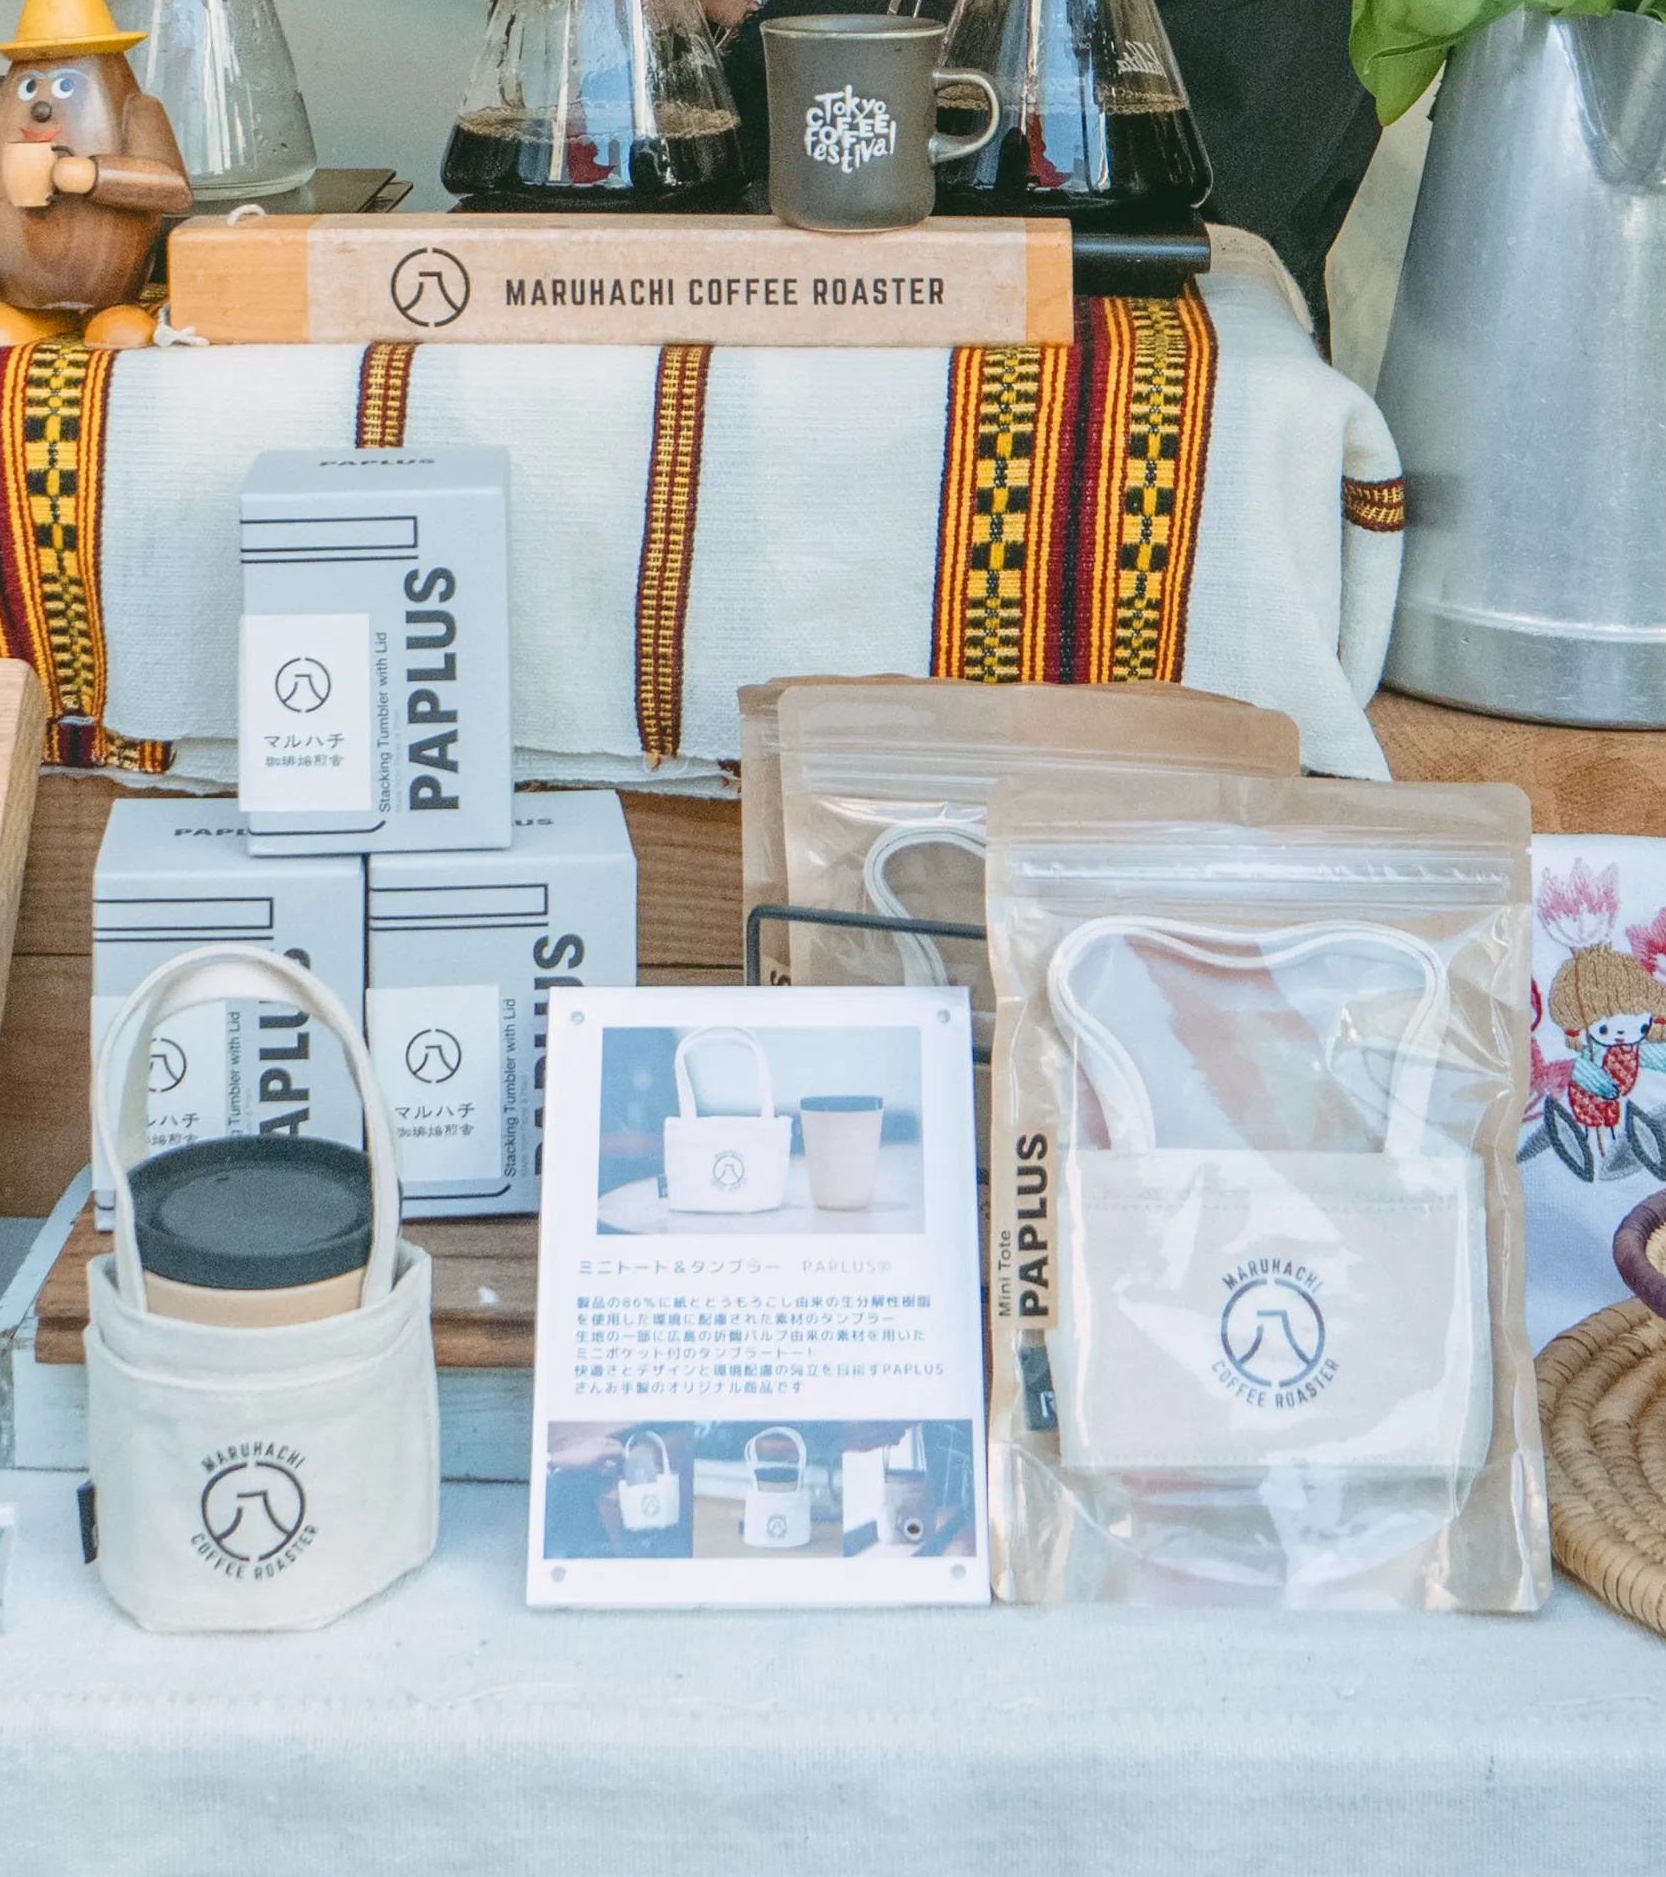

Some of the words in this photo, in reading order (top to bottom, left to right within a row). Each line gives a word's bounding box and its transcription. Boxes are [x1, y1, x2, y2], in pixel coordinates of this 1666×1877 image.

[815, 85, 886, 124] Tokyo
[806, 107, 890, 149] COFFEE
[504, 278, 676, 308] MARUHACHI
[688, 277, 799, 307] COFFEE
[811, 276, 946, 307] ROASTER
[319, 458, 437, 467] PAPLUS
[374, 632, 388, 654] Lid
[375, 657, 389, 686] with
[403, 566, 460, 812] PAPLUS
[376, 690, 391, 748] Tumbler
[263, 733, 346, 750] マルハチ
[377, 751, 393, 814] Stacking
[228, 1011, 241, 1032] Lid
[503, 998, 516, 1020] Lid
[228, 1036, 241, 1065] with
[503, 1023, 516, 1052] with
[228, 1070, 241, 1126] Tumbler
[503, 1055, 517, 1114] Tumbler
[394, 1101, 476, 1121] マルハチ
[504, 1117, 520, 1178] Stacking
[1015, 1132, 1050, 1318] PAPLUS
[997, 1228, 1013, 1265] Tote
[1221, 1256, 1323, 1294] MARUHACHI
[997, 1272, 1013, 1319] Mini
[1209, 1358, 1265, 1410] COFFEE
[1274, 1357, 1342, 1410] ROASTER
[201, 1441, 306, 1474] MARUHACHI
[190, 1533, 245, 1580] COFFEE
[254, 1524, 320, 1580] ROASTER
